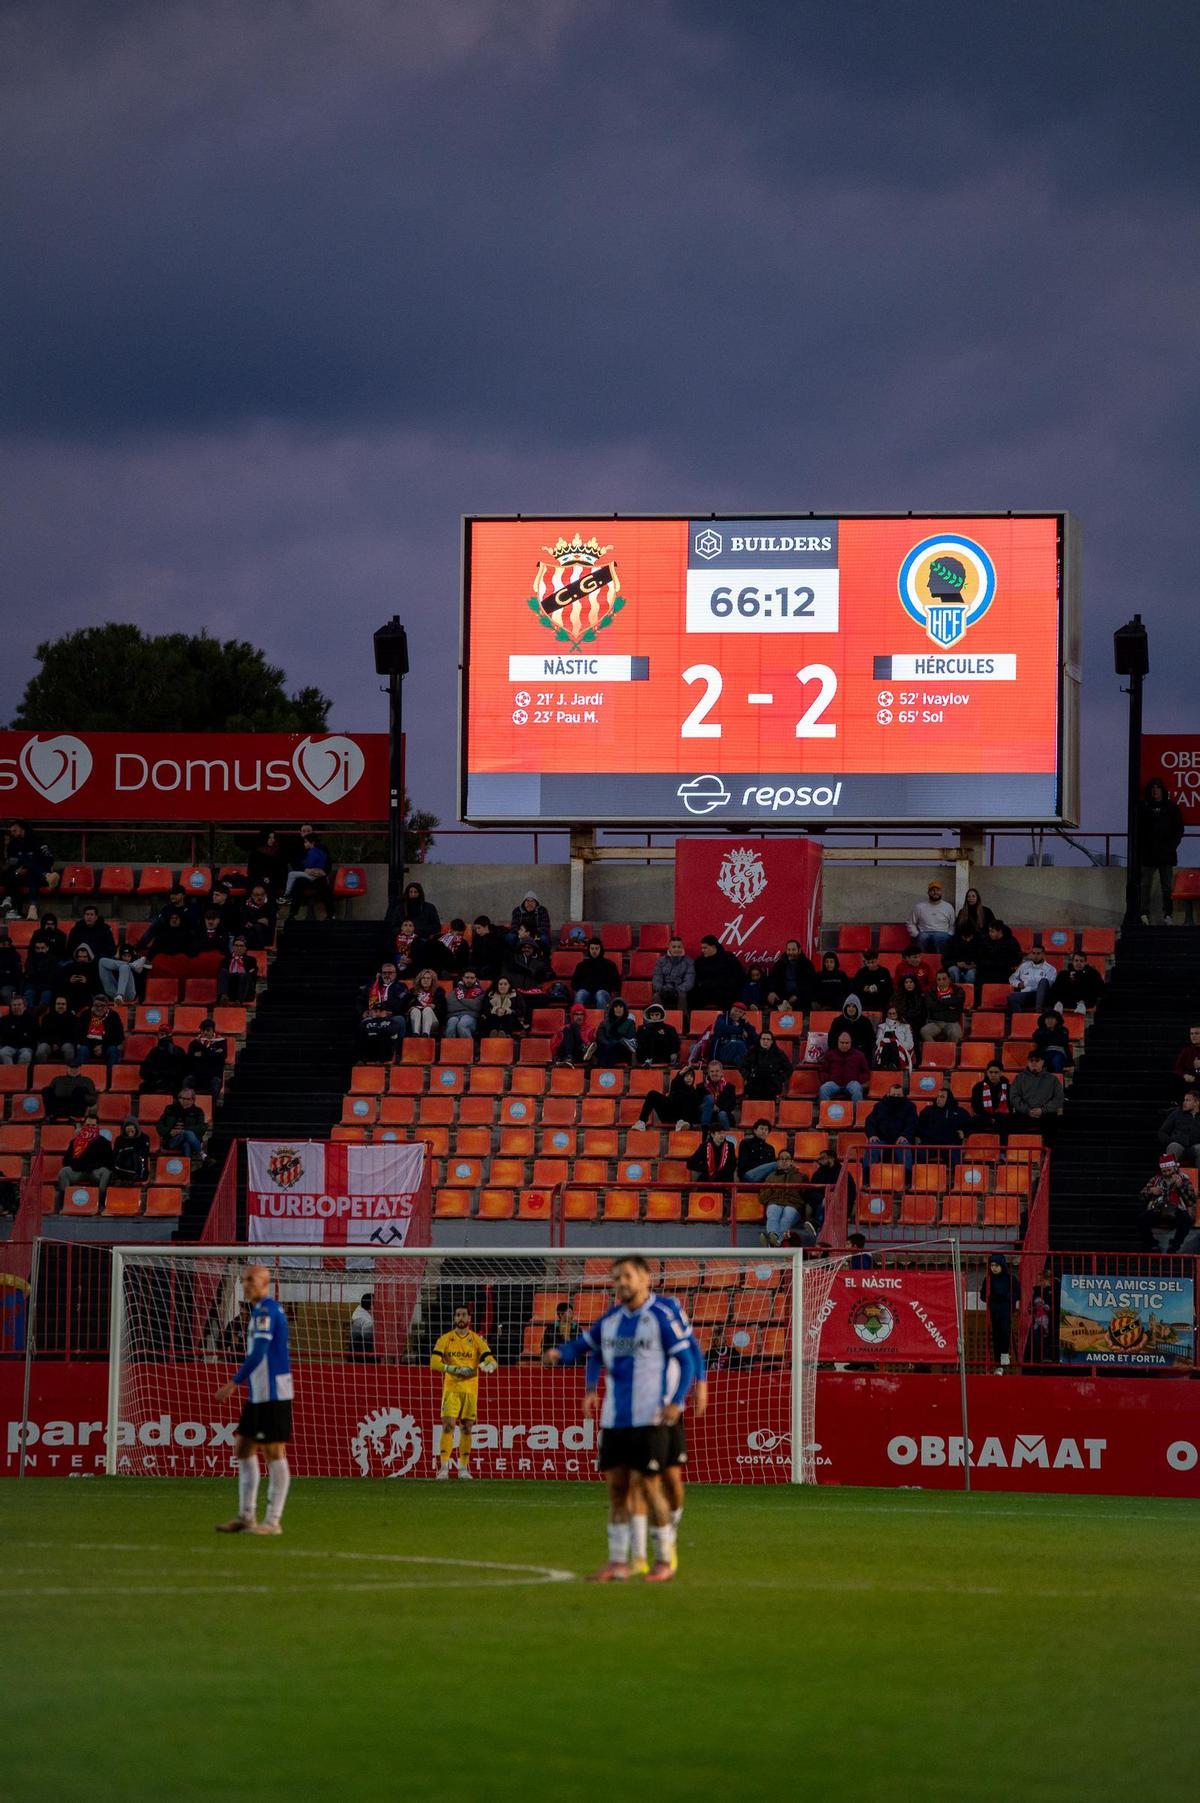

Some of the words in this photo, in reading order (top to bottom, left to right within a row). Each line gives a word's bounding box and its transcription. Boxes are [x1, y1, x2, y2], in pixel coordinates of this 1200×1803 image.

[731, 536, 832, 551] BUILDERS
[710, 586, 815, 617] 66:12
[932, 607, 962, 641] HCF
[543, 657, 598, 675] NÀSTIC
[914, 655, 995, 674] HÉRCULES
[556, 693, 567, 706] J.
[570, 691, 604, 705] Jardí
[681, 663, 723, 738] 2
[795, 663, 838, 738] 2
[922, 691, 970, 708] Ivaylov
[556, 711, 581, 724] Pau
[584, 711, 599, 724] M.
[922, 710, 944, 724] Sol
[742, 782, 843, 811] repsol
[256, 1194, 414, 1218] TURBOPETATS
[844, 1277, 857, 1289] EL
[861, 1275, 903, 1289] NÀSTIC
[1071, 1279, 1112, 1290] PENYA
[1115, 1280, 1156, 1292] AMICS
[1159, 1281, 1184, 1292] DEL
[1087, 1290, 1164, 1310] NÀSTIC
[924, 1320, 948, 1350] SANG
[1086, 1353, 1116, 1362] AMOR
[1117, 1354, 1130, 1362] ET
[1131, 1354, 1166, 1364] FORTIA
[736, 1455, 774, 1465] COSTA
[886, 1434, 1108, 1470] OBRAMAT
